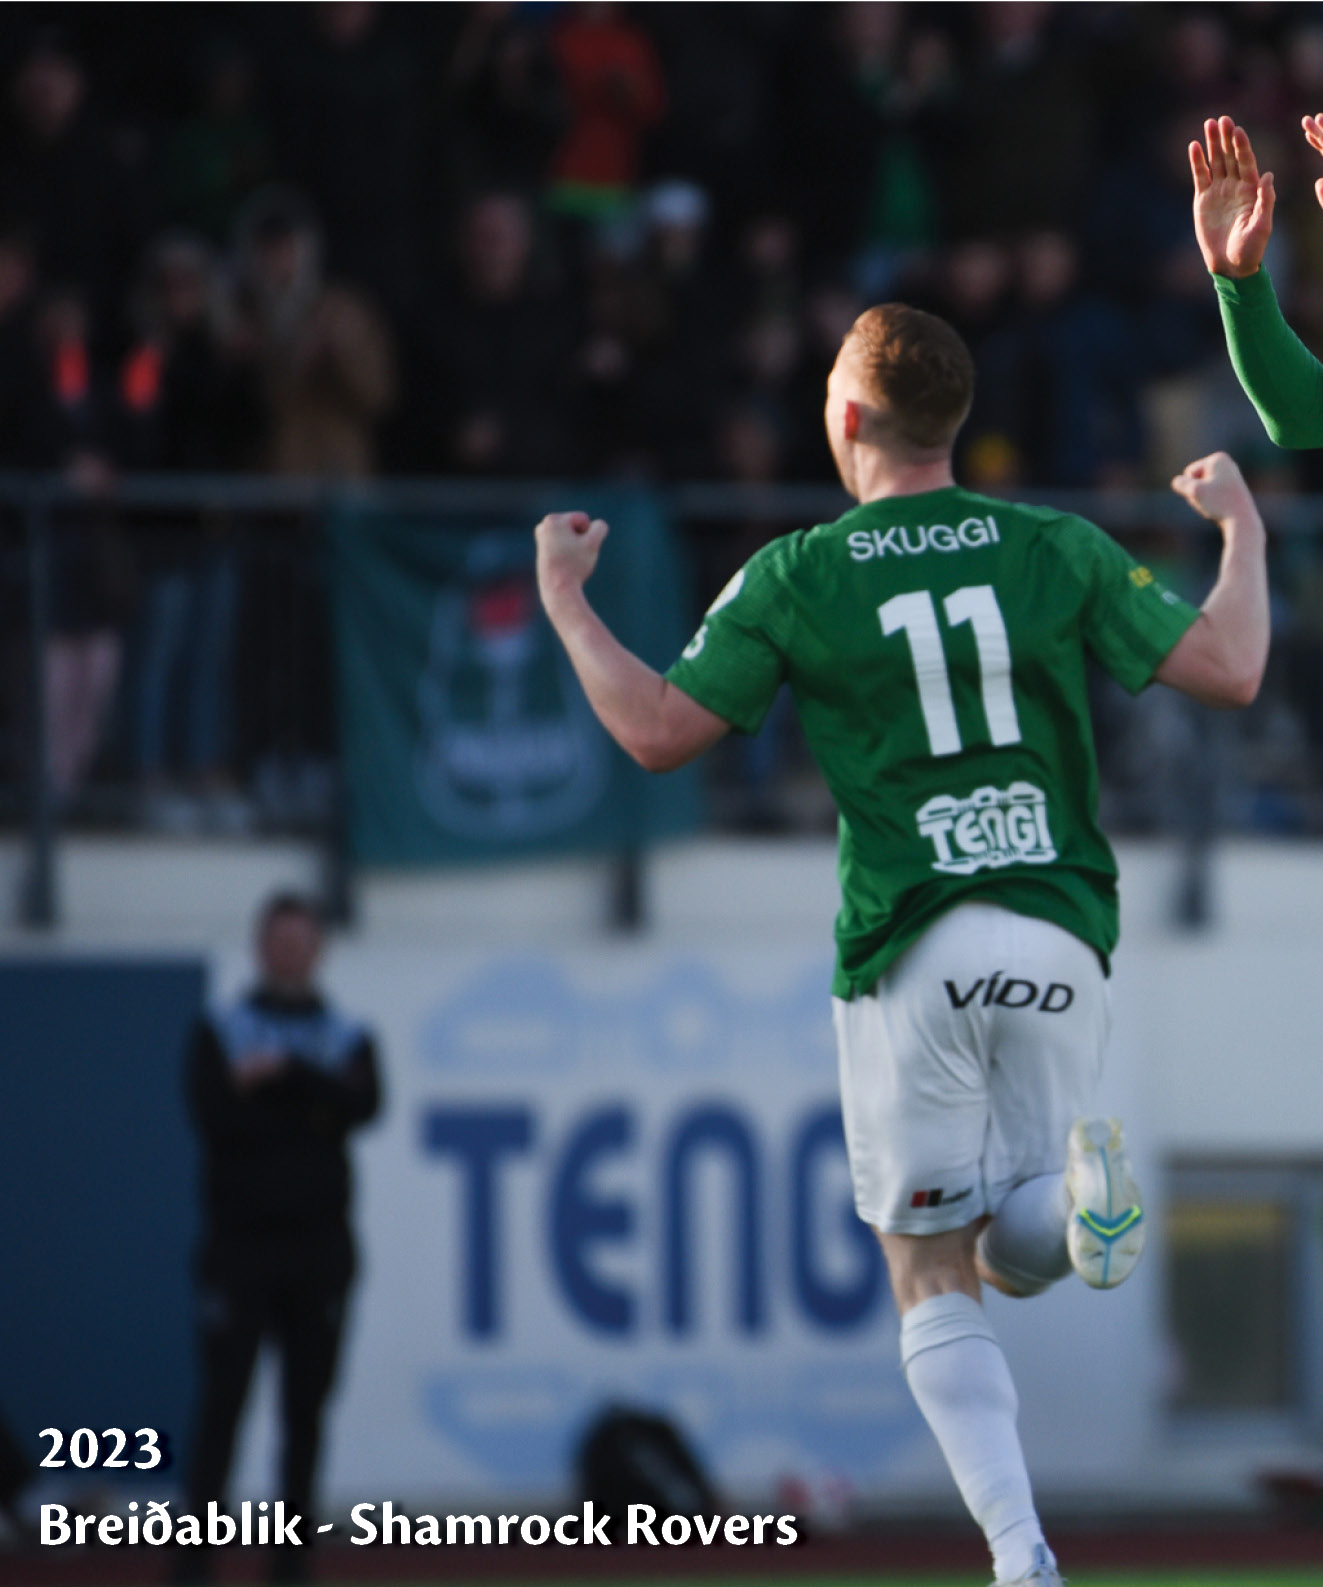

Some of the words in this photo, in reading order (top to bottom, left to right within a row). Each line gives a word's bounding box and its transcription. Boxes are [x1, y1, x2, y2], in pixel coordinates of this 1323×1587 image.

[846, 515, 1000, 562] SKUGGI
[877, 584, 1022, 757] 11
[918, 803, 1057, 865] TENGI
[943, 970, 1075, 1013] VÍDD
[420, 1098, 884, 1342] TENG
